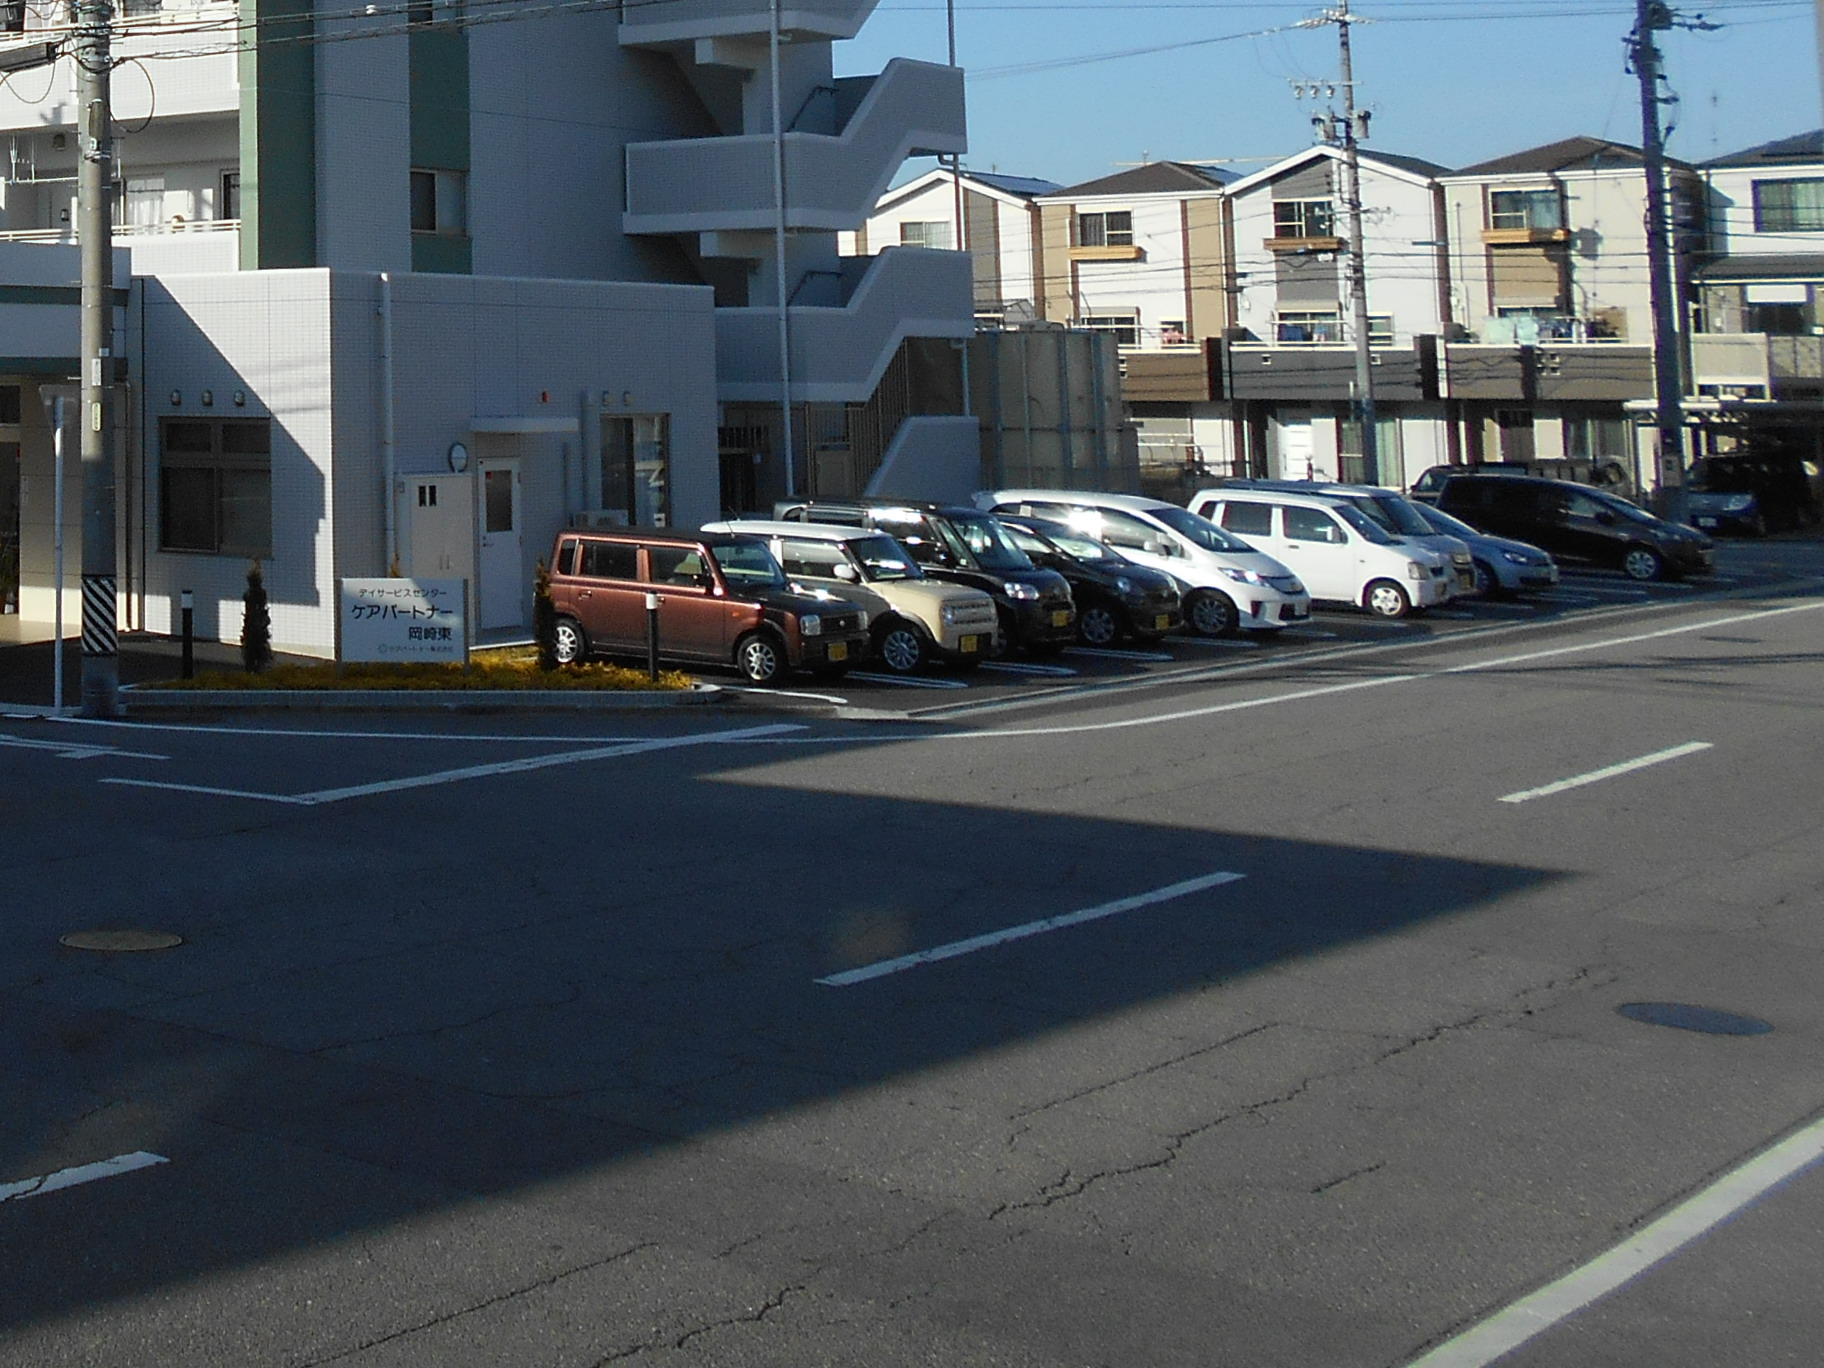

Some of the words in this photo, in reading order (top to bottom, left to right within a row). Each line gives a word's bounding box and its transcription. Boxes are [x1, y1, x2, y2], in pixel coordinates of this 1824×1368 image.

[358, 588, 447, 598] デイサービスセンター
[351, 604, 453, 620] ケアパートナー
[408, 626, 452, 641] 岡崎東
